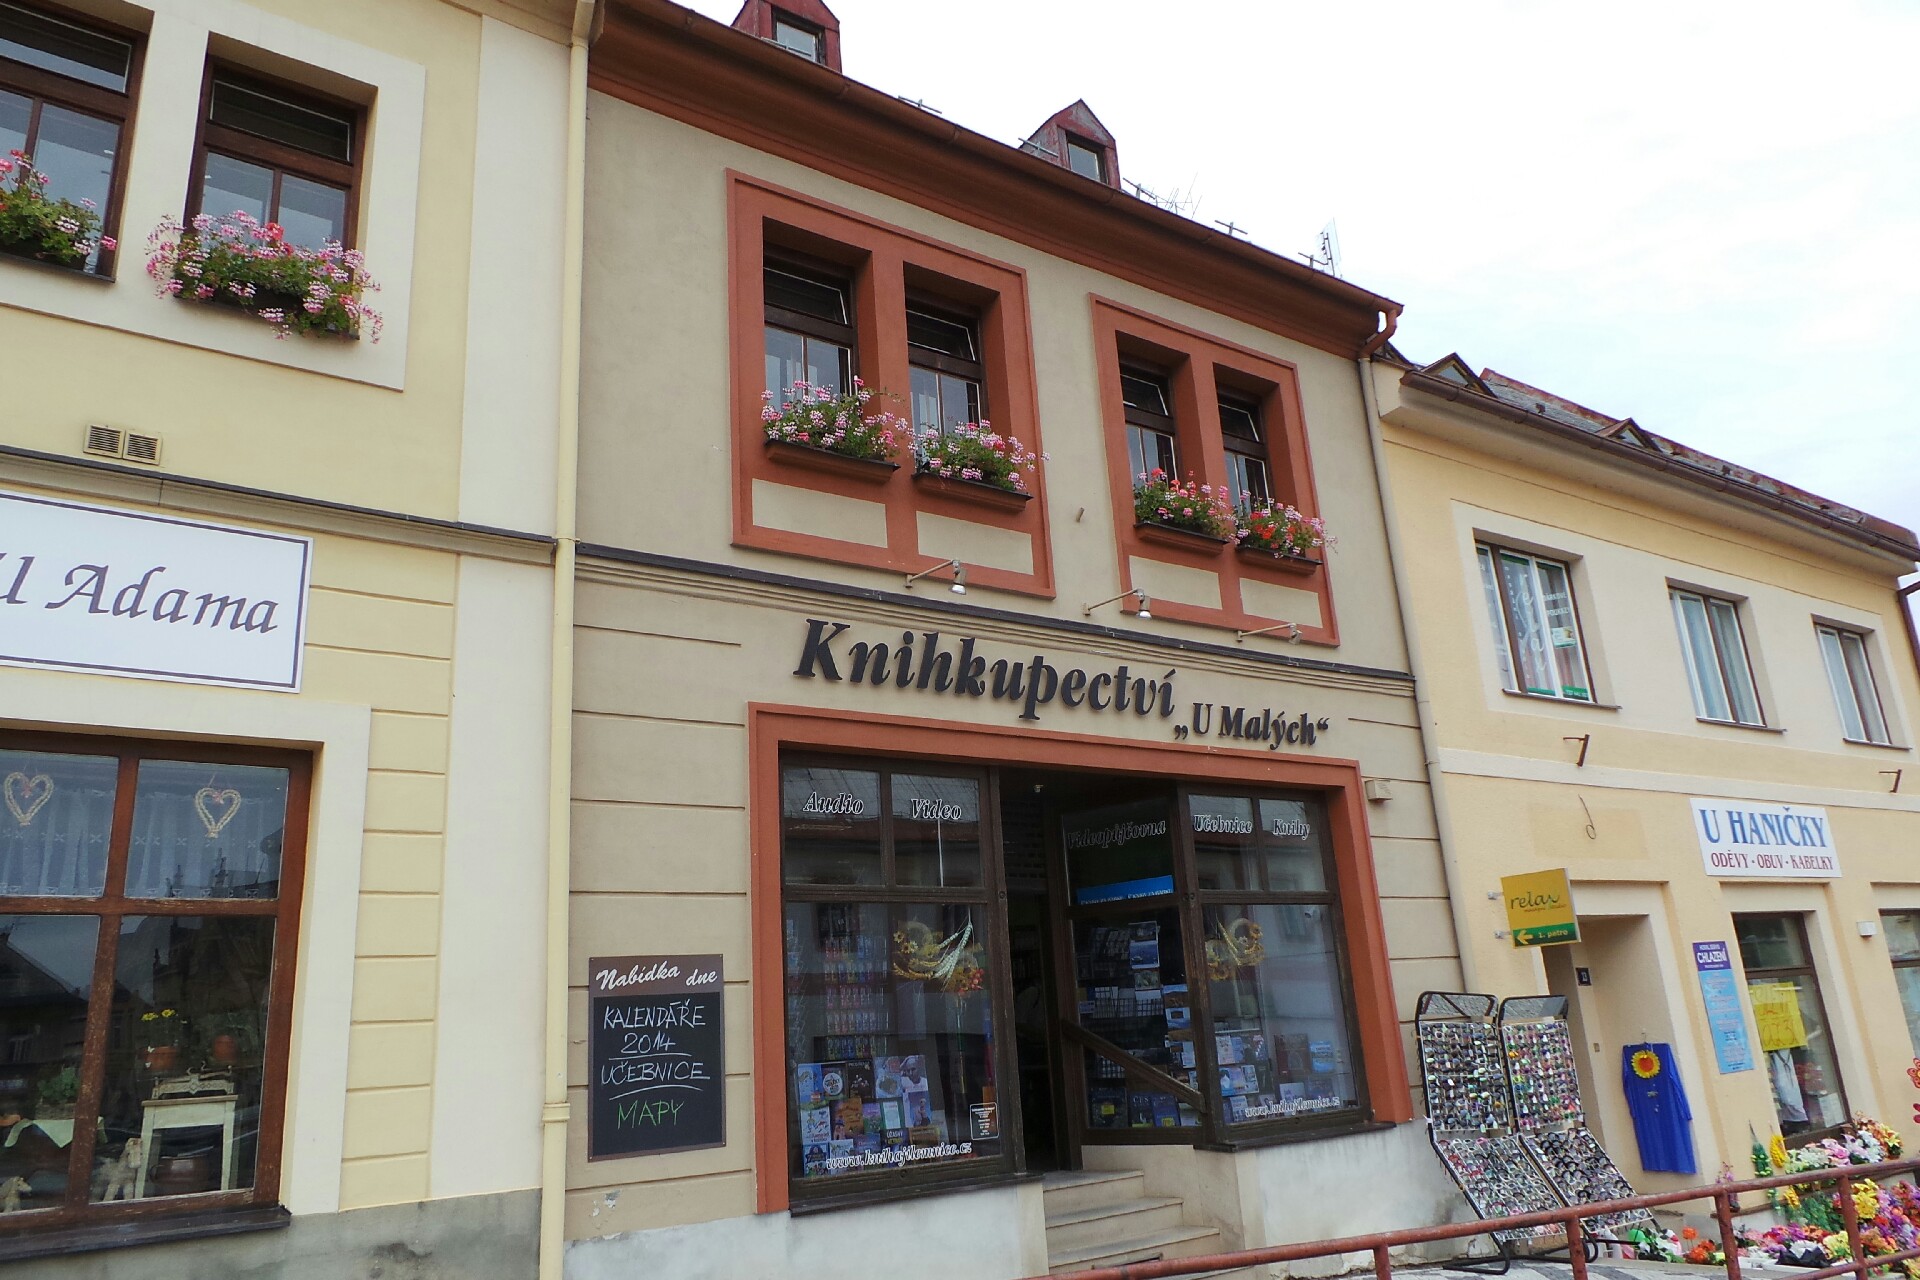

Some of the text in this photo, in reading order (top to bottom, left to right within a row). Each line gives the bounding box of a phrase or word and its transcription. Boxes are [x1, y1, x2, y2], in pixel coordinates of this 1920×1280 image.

[45, 564, 279, 633] Adama
[793, 618, 1176, 720] Knihkupectví
[1218, 708, 1330, 751] Malých“
[803, 791, 864, 815] Audio
[911, 798, 962, 820] Video
[1067, 820, 1167, 849] Videopůjčovna
[1193, 814, 1253, 834] Učebnice
[1272, 818, 1311, 841] Knihy
[1699, 806, 1828, 848] U HANIČKY
[1711, 850, 1835, 870] ODĚVY OBUV KABELKY
[596, 960, 718, 991] Nabídka dne
[603, 998, 706, 1029] KALENDÁŘE
[620, 1030, 676, 1054] 2014
[601, 1061, 711, 1085] UČEBNICE
[617, 1099, 684, 1130] MAPY
